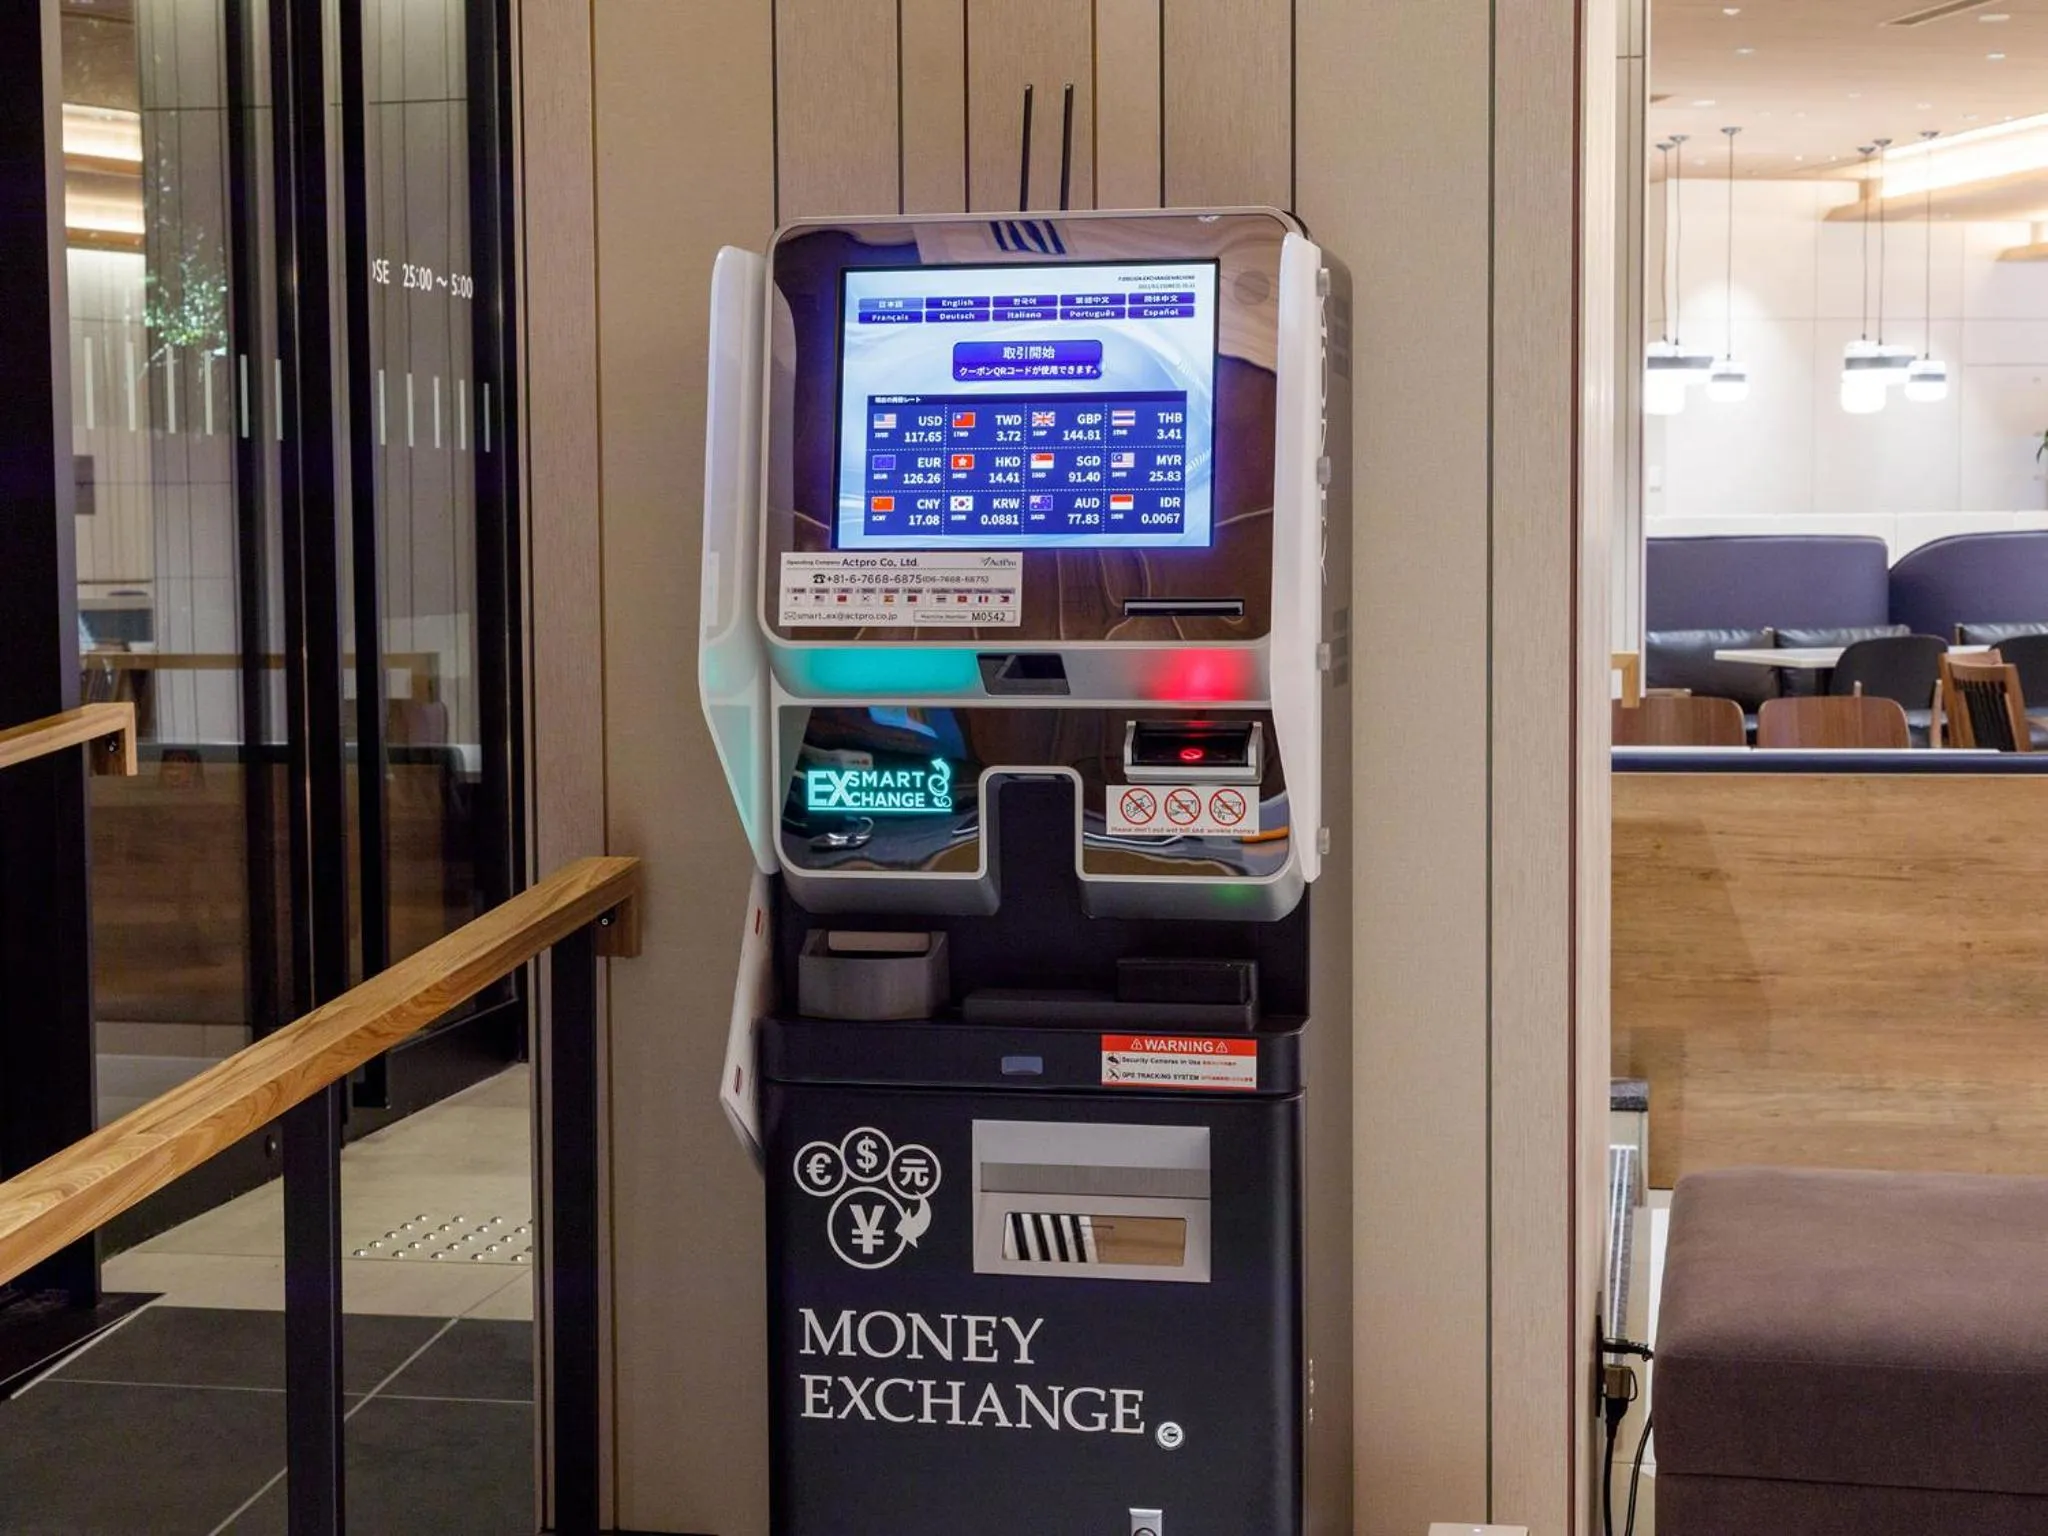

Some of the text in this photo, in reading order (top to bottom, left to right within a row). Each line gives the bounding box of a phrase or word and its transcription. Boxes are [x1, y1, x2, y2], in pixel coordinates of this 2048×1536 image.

[402, 263, 433, 292] 25:00
[451, 273, 473, 299] 5:00
[941, 299, 974, 308] English
[872, 313, 909, 322] Français
[939, 313, 975, 321] Deutsch
[1007, 311, 1042, 319] Italiano
[1069, 309, 1115, 319] Português
[1143, 308, 1179, 317] Español
[1003, 346, 1055, 359] 取引開始
[918, 416, 942, 426] USD
[995, 415, 1022, 425] TWD
[1077, 413, 1101, 424] GBP
[1158, 412, 1183, 423] THB
[904, 432, 942, 443] 117.65
[996, 431, 1022, 442] 3.72
[1063, 430, 1100, 441] 144.81
[1157, 429, 1182, 439] 3.41
[918, 457, 941, 468] EUR
[995, 457, 1021, 467] HKD
[1076, 455, 1100, 466] SGD
[1156, 455, 1181, 466] MYR
[903, 473, 941, 484] 126.26
[989, 473, 1020, 483] 14.41
[1068, 471, 1100, 482] 91.40
[1150, 471, 1181, 481] 25.83
[917, 499, 941, 510] CNY
[993, 498, 1020, 509] KRW
[1074, 497, 1100, 508] AUD
[1160, 497, 1181, 508] IDR
[908, 515, 940, 525] 17.08
[981, 514, 1019, 525] 0.0881
[1068, 514, 1100, 524] 77.83
[1141, 513, 1180, 524] 0.0067
[842, 558, 877, 567] Actpro
[971, 612, 1006, 621] M0542
[848, 771, 925, 788] SMART
[1144, 1039, 1214, 1053] WARNING
[1122, 1056, 1149, 1065] Security
[1150, 1057, 1179, 1065] Cameras
[1137, 1072, 1172, 1080] TRACKING
[1173, 1073, 1200, 1081] SYSTEM
[799, 1308, 1044, 1365] MONEY
[800, 1374, 1145, 1435] EXCHANGE
